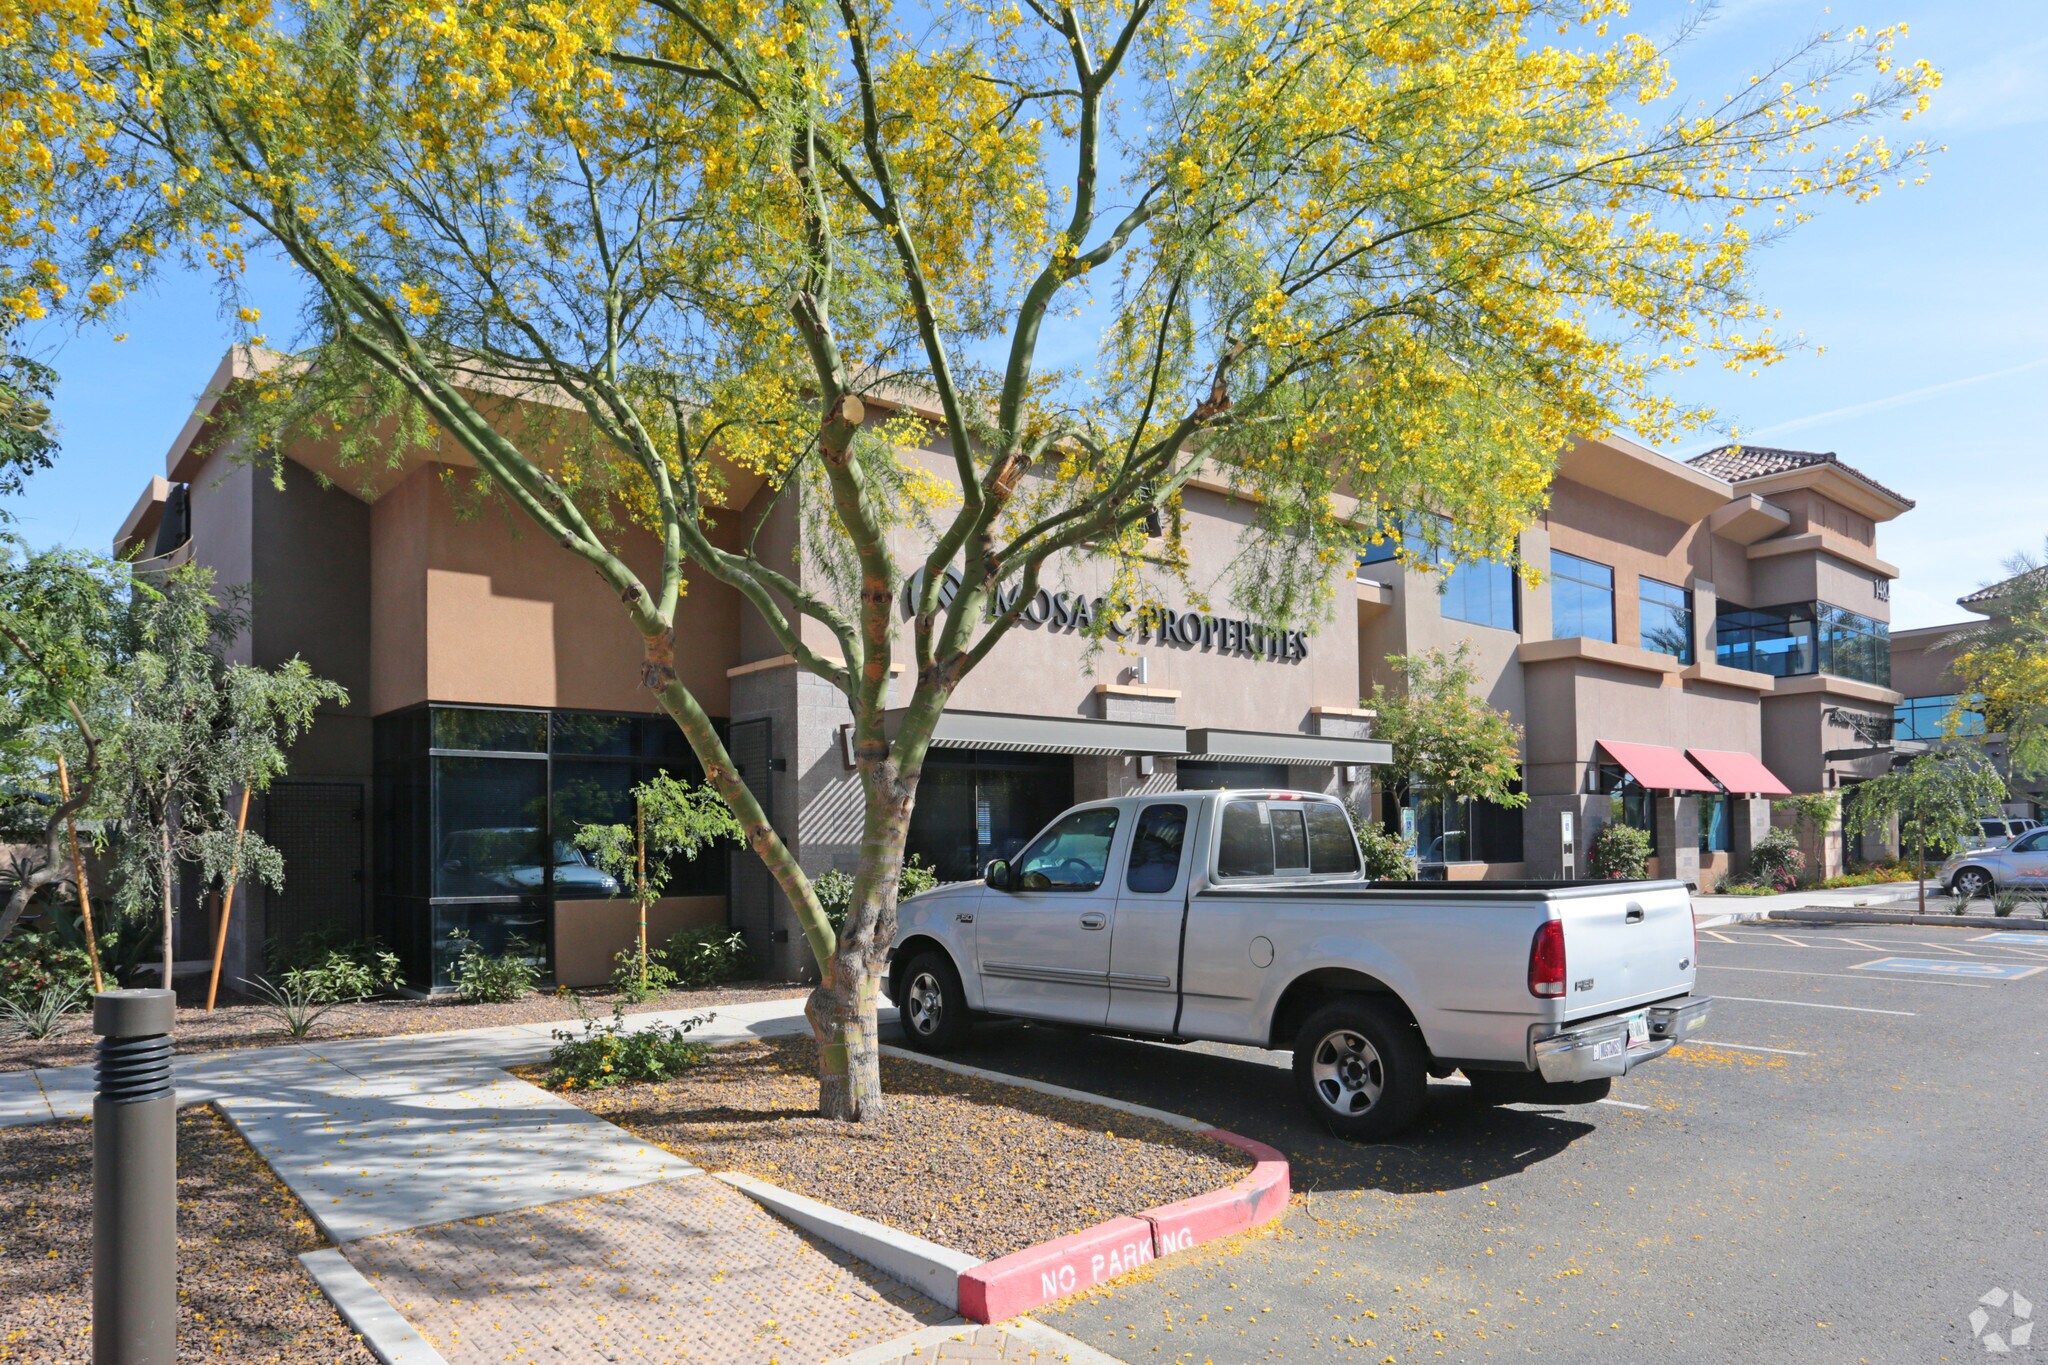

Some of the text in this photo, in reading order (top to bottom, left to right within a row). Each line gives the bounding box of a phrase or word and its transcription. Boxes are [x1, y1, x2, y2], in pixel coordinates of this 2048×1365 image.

[1139, 605, 1308, 660] PROPERTIES
[1041, 1227, 1193, 1298] NO PARKNG
